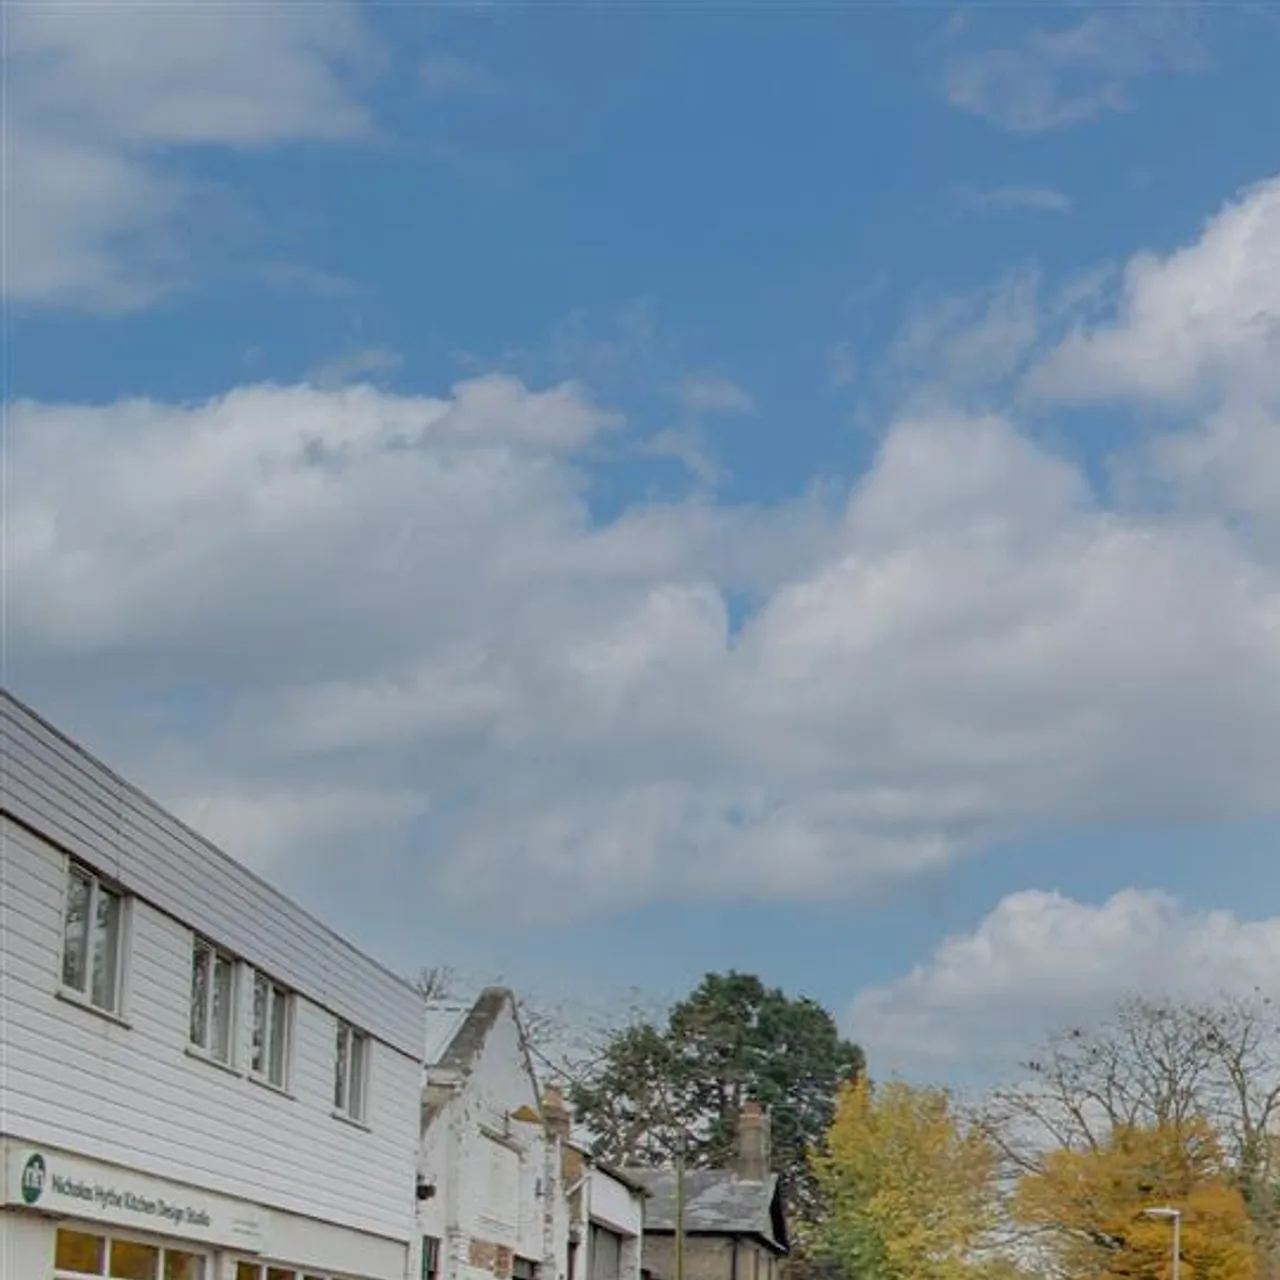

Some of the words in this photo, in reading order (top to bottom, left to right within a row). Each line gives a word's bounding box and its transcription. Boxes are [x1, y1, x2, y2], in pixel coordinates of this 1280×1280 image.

[52, 1173, 93, 1200] Nicholas
[123, 1191, 156, 1215] Kitchen
[157, 1198, 184, 1227] Design
[186, 1205, 211, 1228] Studio
